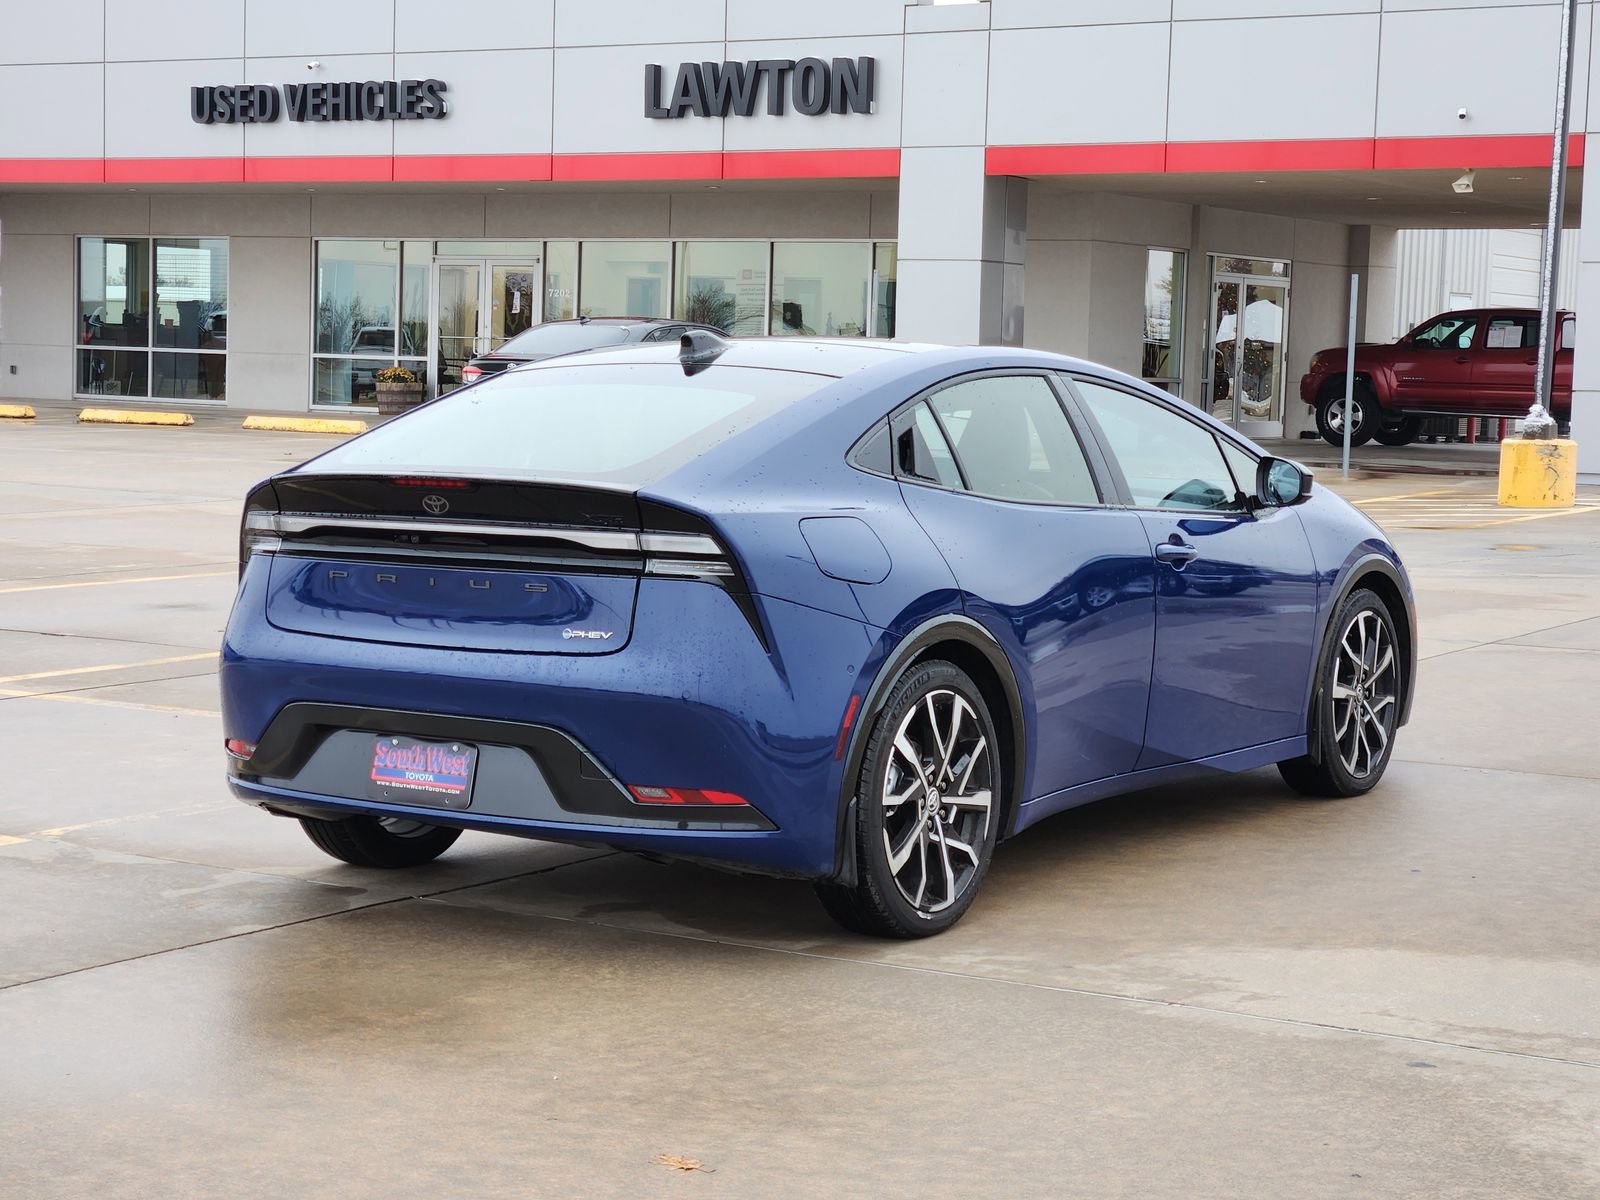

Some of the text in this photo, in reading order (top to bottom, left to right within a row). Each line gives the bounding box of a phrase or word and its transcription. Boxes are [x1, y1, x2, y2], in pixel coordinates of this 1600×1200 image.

[644, 56, 875, 119] LAWTON
[190, 78, 448, 124] USED VEHICLES
[548, 288, 572, 297] 7202
[328, 569, 549, 593] PRIUS
[405, 771, 434, 783] TOYOTA
